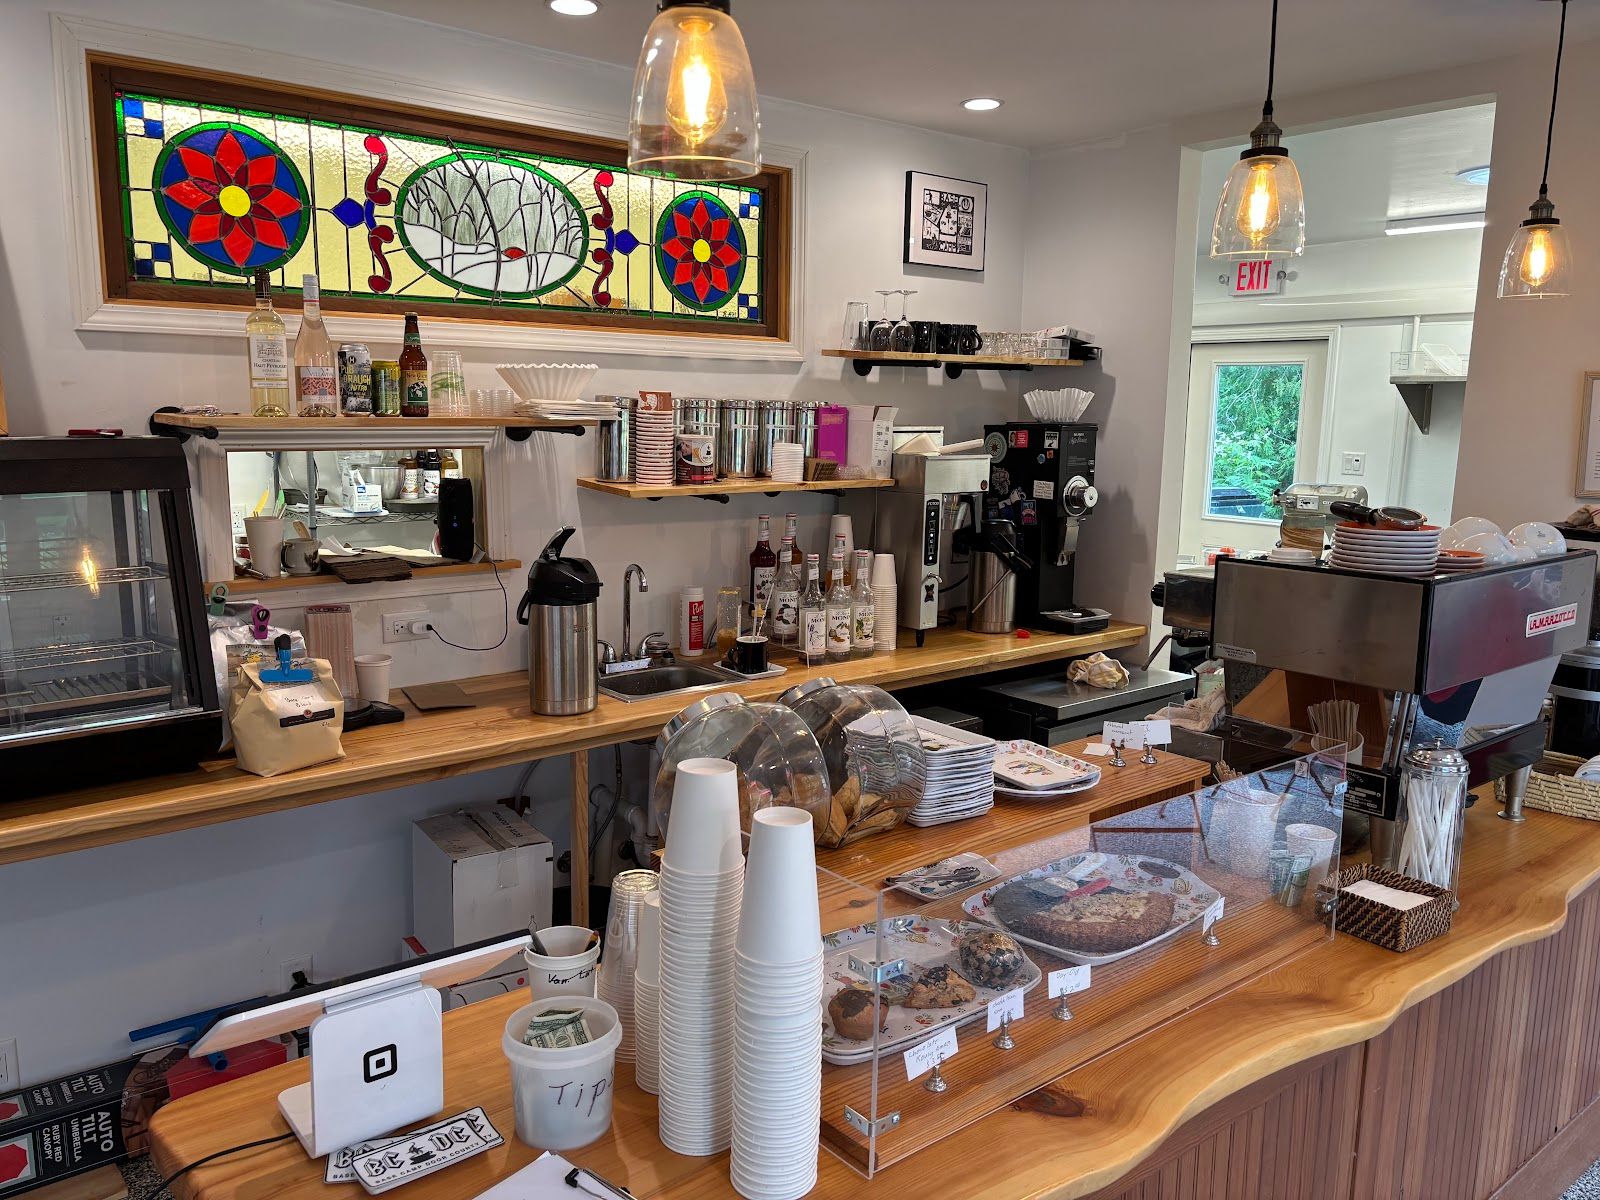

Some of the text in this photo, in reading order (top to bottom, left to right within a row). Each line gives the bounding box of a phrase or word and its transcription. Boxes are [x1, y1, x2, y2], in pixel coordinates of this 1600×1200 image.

[1236, 260, 1273, 291] EXIT
[32, 1089, 44, 1107] CANOPY
[70, 1076, 88, 1094] TILT
[86, 1074, 105, 1095] AUTO
[42, 1127, 53, 1160] CANOPY
[51, 1124, 63, 1163] RUBY RED
[70, 1117, 83, 1163] UMBRELLA
[81, 1113, 97, 1143] TILT
[97, 1111, 115, 1152] AUTO
[399, 1163, 423, 1176] CAMP
[424, 1154, 448, 1167] DOOR
[449, 1140, 480, 1158] COUNTY
